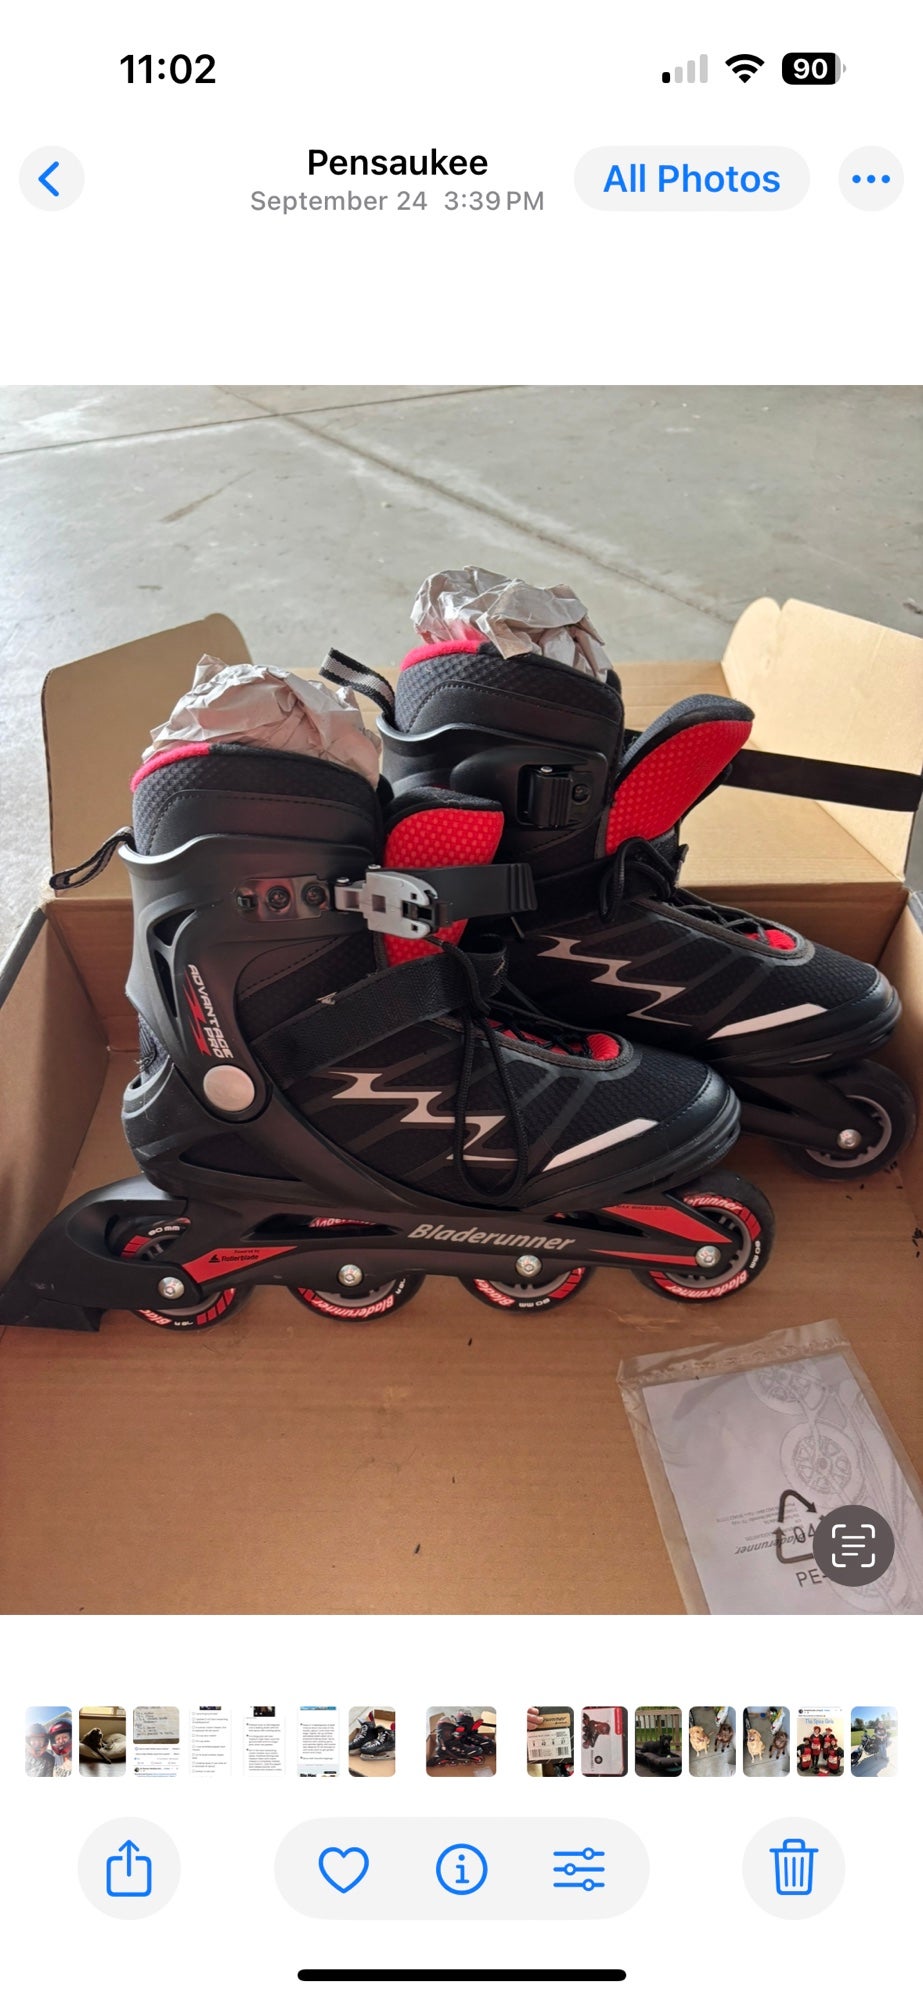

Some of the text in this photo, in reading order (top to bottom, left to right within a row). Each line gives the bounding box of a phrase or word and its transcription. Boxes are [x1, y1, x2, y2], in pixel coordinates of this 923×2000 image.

[120, 53, 216, 85] 11:02
[793, 58, 828, 80] 90
[308, 147, 489, 176] Pensaukee
[602, 163, 781, 194] All Photos
[250, 189, 544, 216] September 24 3:39 PM
[188, 964, 234, 1059] ADVANTAGE
[203, 1026, 225, 1059] PRO
[407, 1223, 576, 1250] Bladerunner
[665, 1270, 748, 1299] Bladerunner
[311, 1295, 394, 1317] Bladerunner
